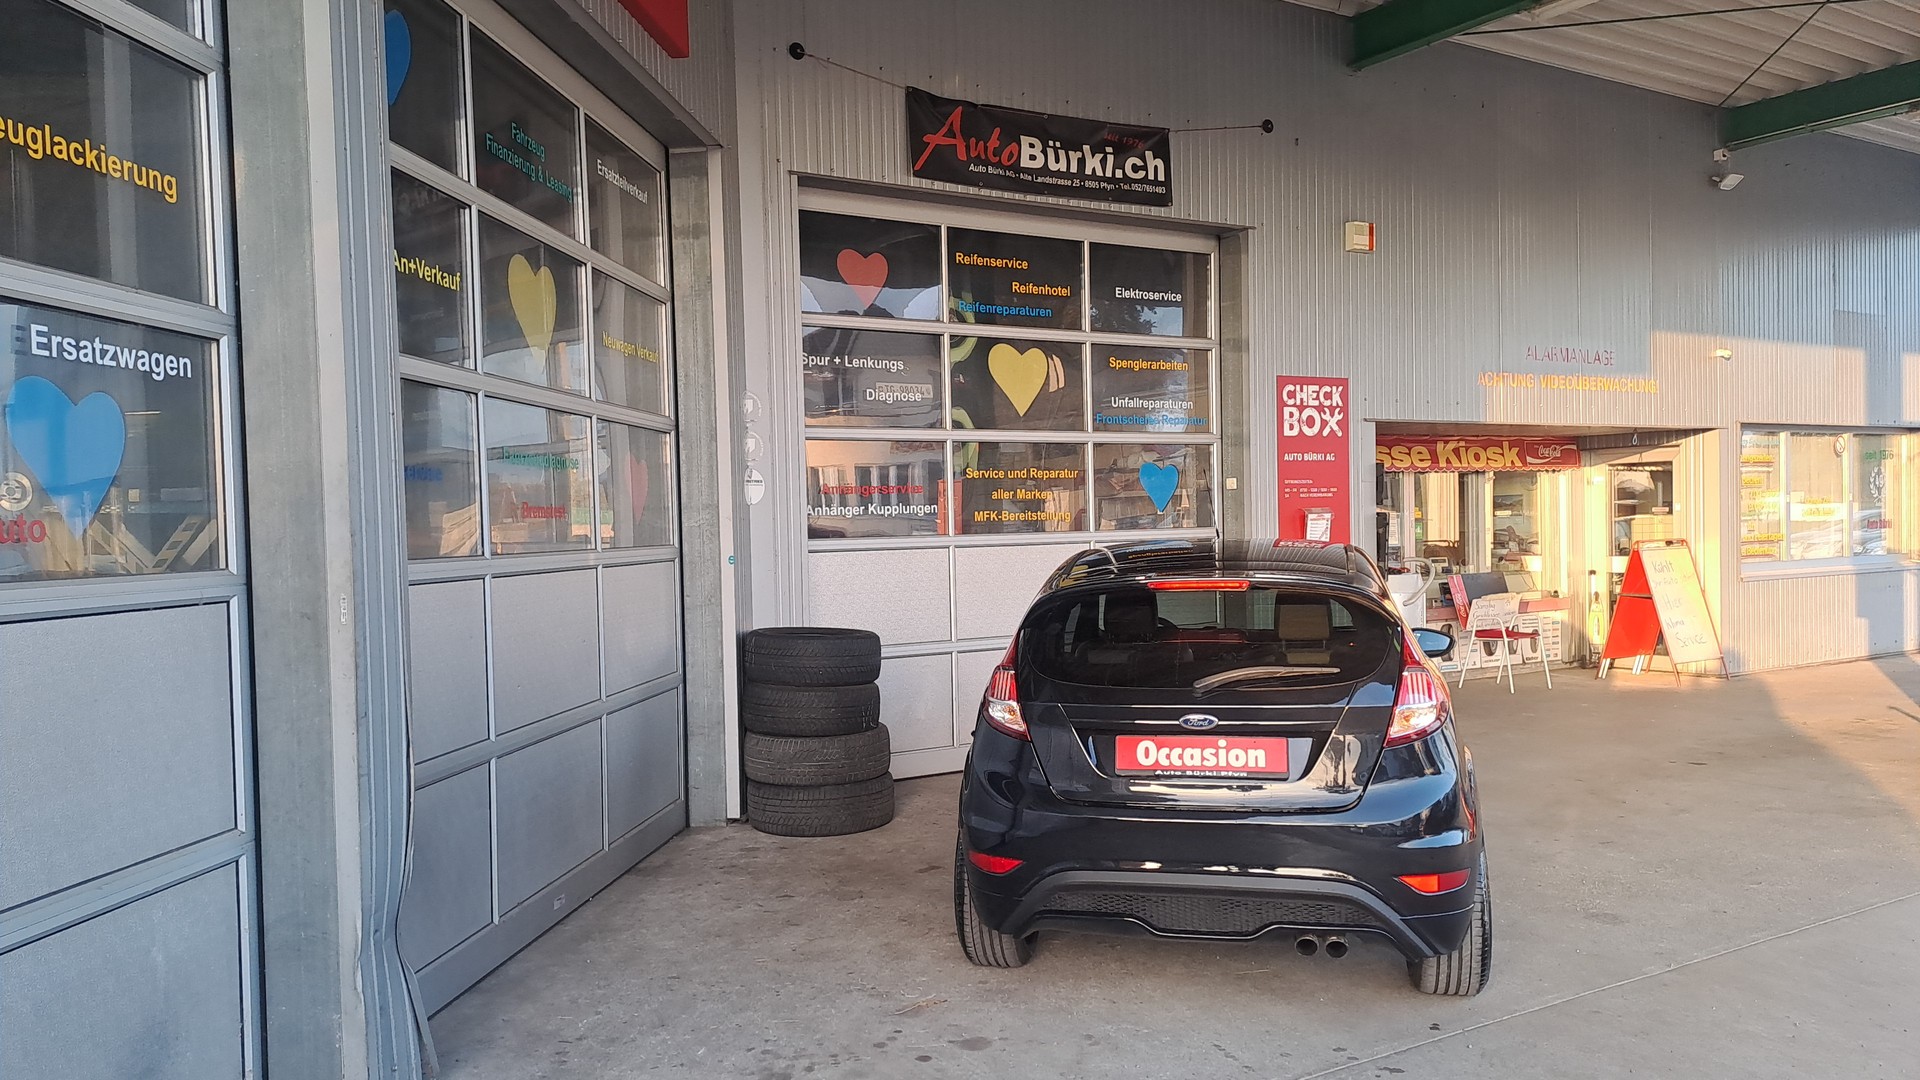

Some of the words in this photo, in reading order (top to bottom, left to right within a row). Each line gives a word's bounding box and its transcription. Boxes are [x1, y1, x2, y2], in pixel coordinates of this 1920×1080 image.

[511, 121, 545, 162] Fahrzeug
[486, 132, 536, 182] Finanzierung
[538, 165, 544, 183] &
[545, 169, 573, 203] Leasing
[969, 163, 986, 173] Auto
[988, 165, 1005, 176] Bürki
[1006, 169, 1016, 178] AG
[1020, 172, 1032, 181] Alte
[1033, 174, 1072, 187] Landstrasse
[1072, 179, 1080, 187] 25
[1085, 180, 1100, 189] 8505
[955, 252, 1029, 270] Reifenservice
[394, 248, 461, 292] An+Verkauf
[1012, 281, 1071, 298] Reifenhotel
[1115, 286, 1182, 302] Elektroservice
[958, 300, 1052, 318] Reifenreparaturen
[602, 330, 635, 357] Neuwagen
[30, 323, 192, 382] Ersatzwagen
[802, 352, 830, 368] Spur
[833, 356, 841, 365] +
[844, 355, 904, 373] Lenkungs
[1109, 357, 1188, 371] Spenglerarbeiten
[1477, 371, 1535, 388] ACHTUNG
[866, 388, 922, 404] Diagnose
[1111, 396, 1193, 410] Unfallreparaturen
[1282, 384, 1344, 407] CHECK
[1283, 406, 1344, 437] BOX
[1284, 452, 1303, 461] AUTO
[1303, 451, 1325, 461] BÜRKI
[1325, 453, 1336, 461] AG
[1436, 440, 1523, 468] Kiosk
[966, 467, 1005, 479] Service
[1007, 468, 1027, 479] und
[1030, 467, 1078, 480] Reparatur
[821, 482, 924, 498] Anhängerservice
[991, 488, 1014, 499] aller
[1016, 488, 1053, 500] Marken
[807, 504, 865, 518] Anhänger
[868, 502, 938, 518] Kupplungen
[974, 510, 1071, 523] MFK-Bereitstellung
[1188, 718, 1209, 727] Ford
[1136, 739, 1266, 768] Occasion
